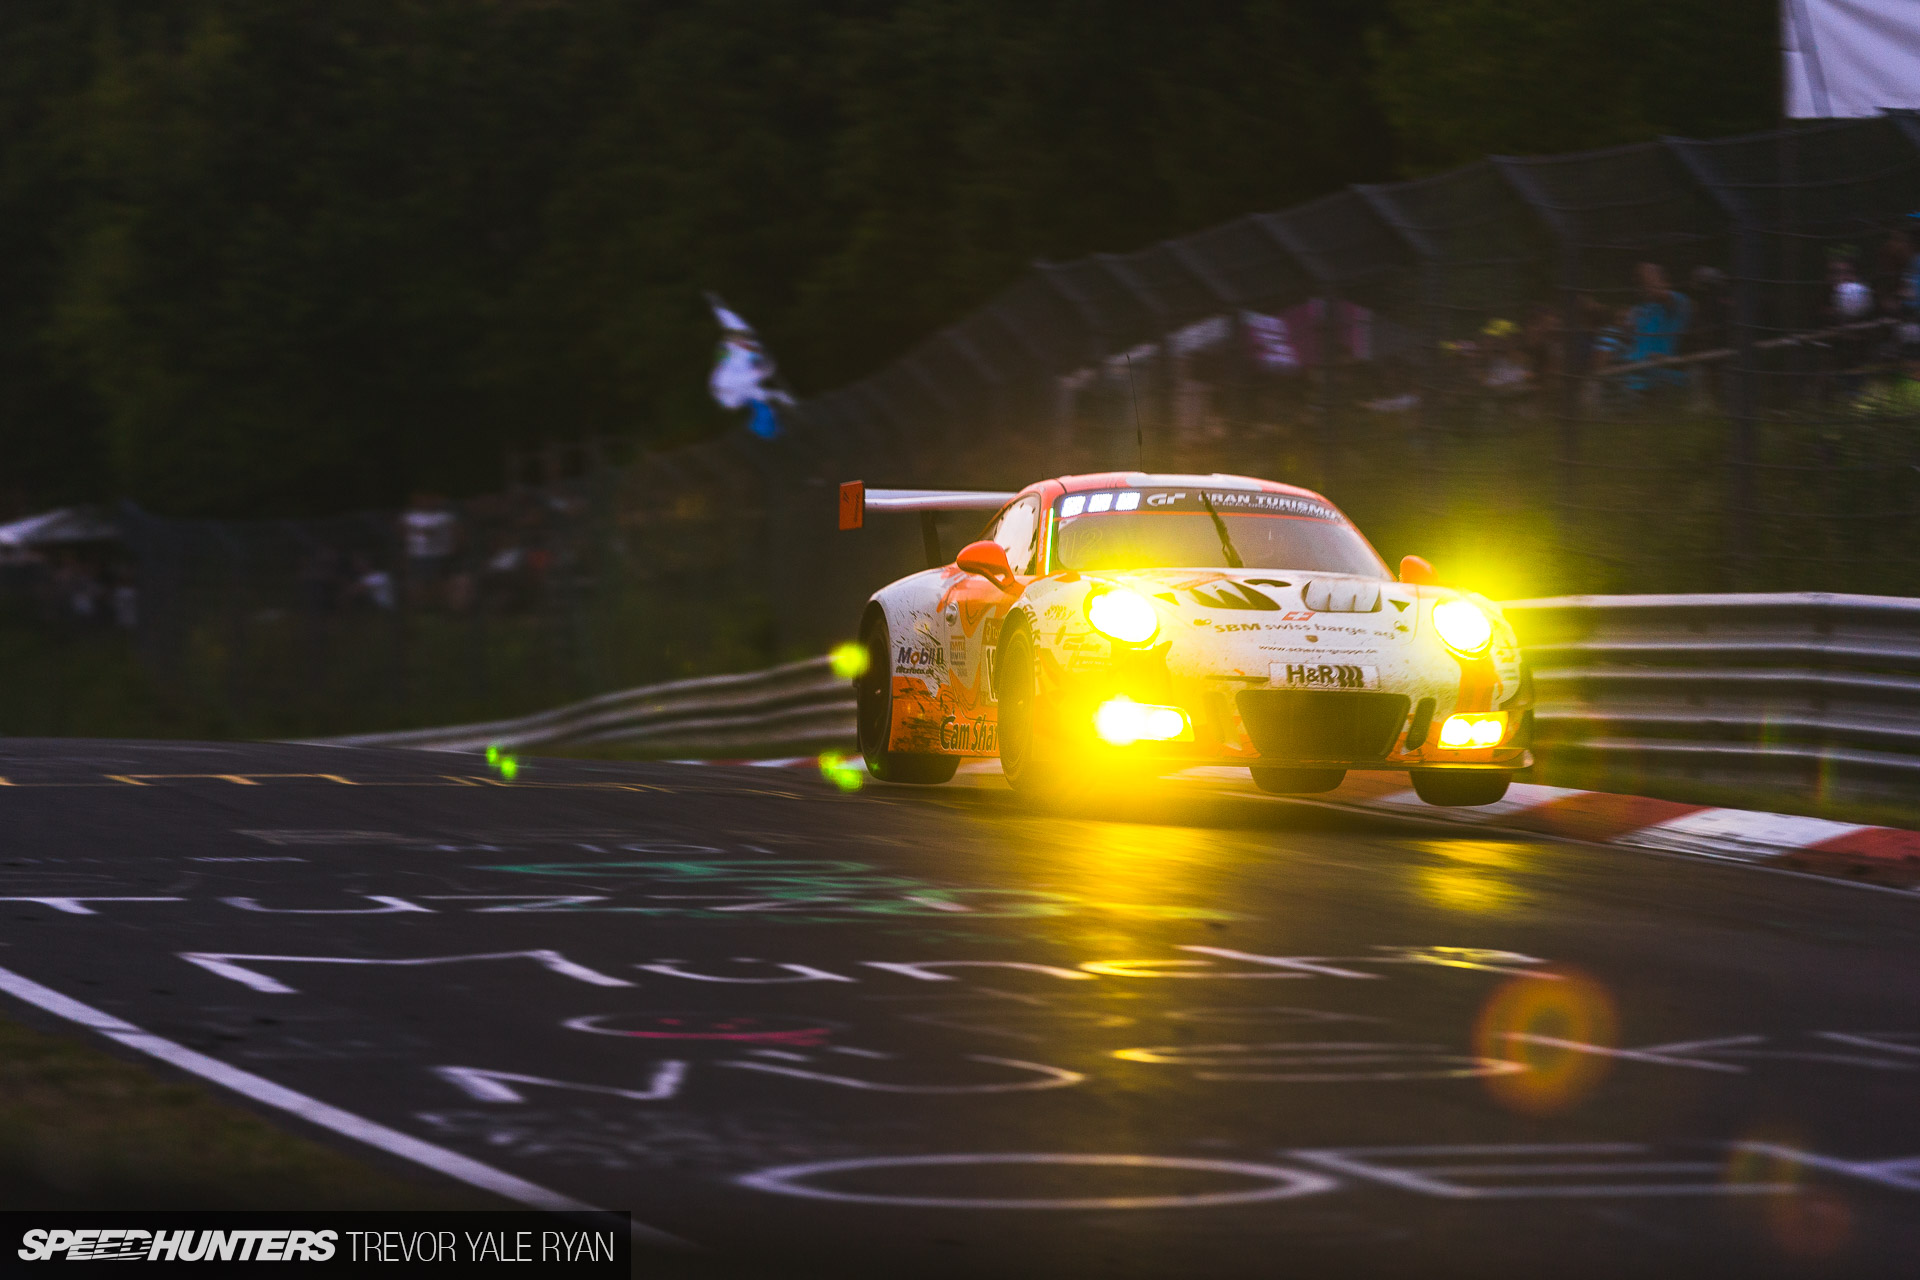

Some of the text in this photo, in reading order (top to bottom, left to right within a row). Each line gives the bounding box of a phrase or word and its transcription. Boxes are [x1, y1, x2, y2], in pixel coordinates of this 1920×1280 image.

[1213, 622, 1262, 633] SBM
[1265, 622, 1310, 631] swiss
[1314, 623, 1368, 635] barge
[897, 646, 936, 665] Mobil
[940, 714, 971, 751] Cam
